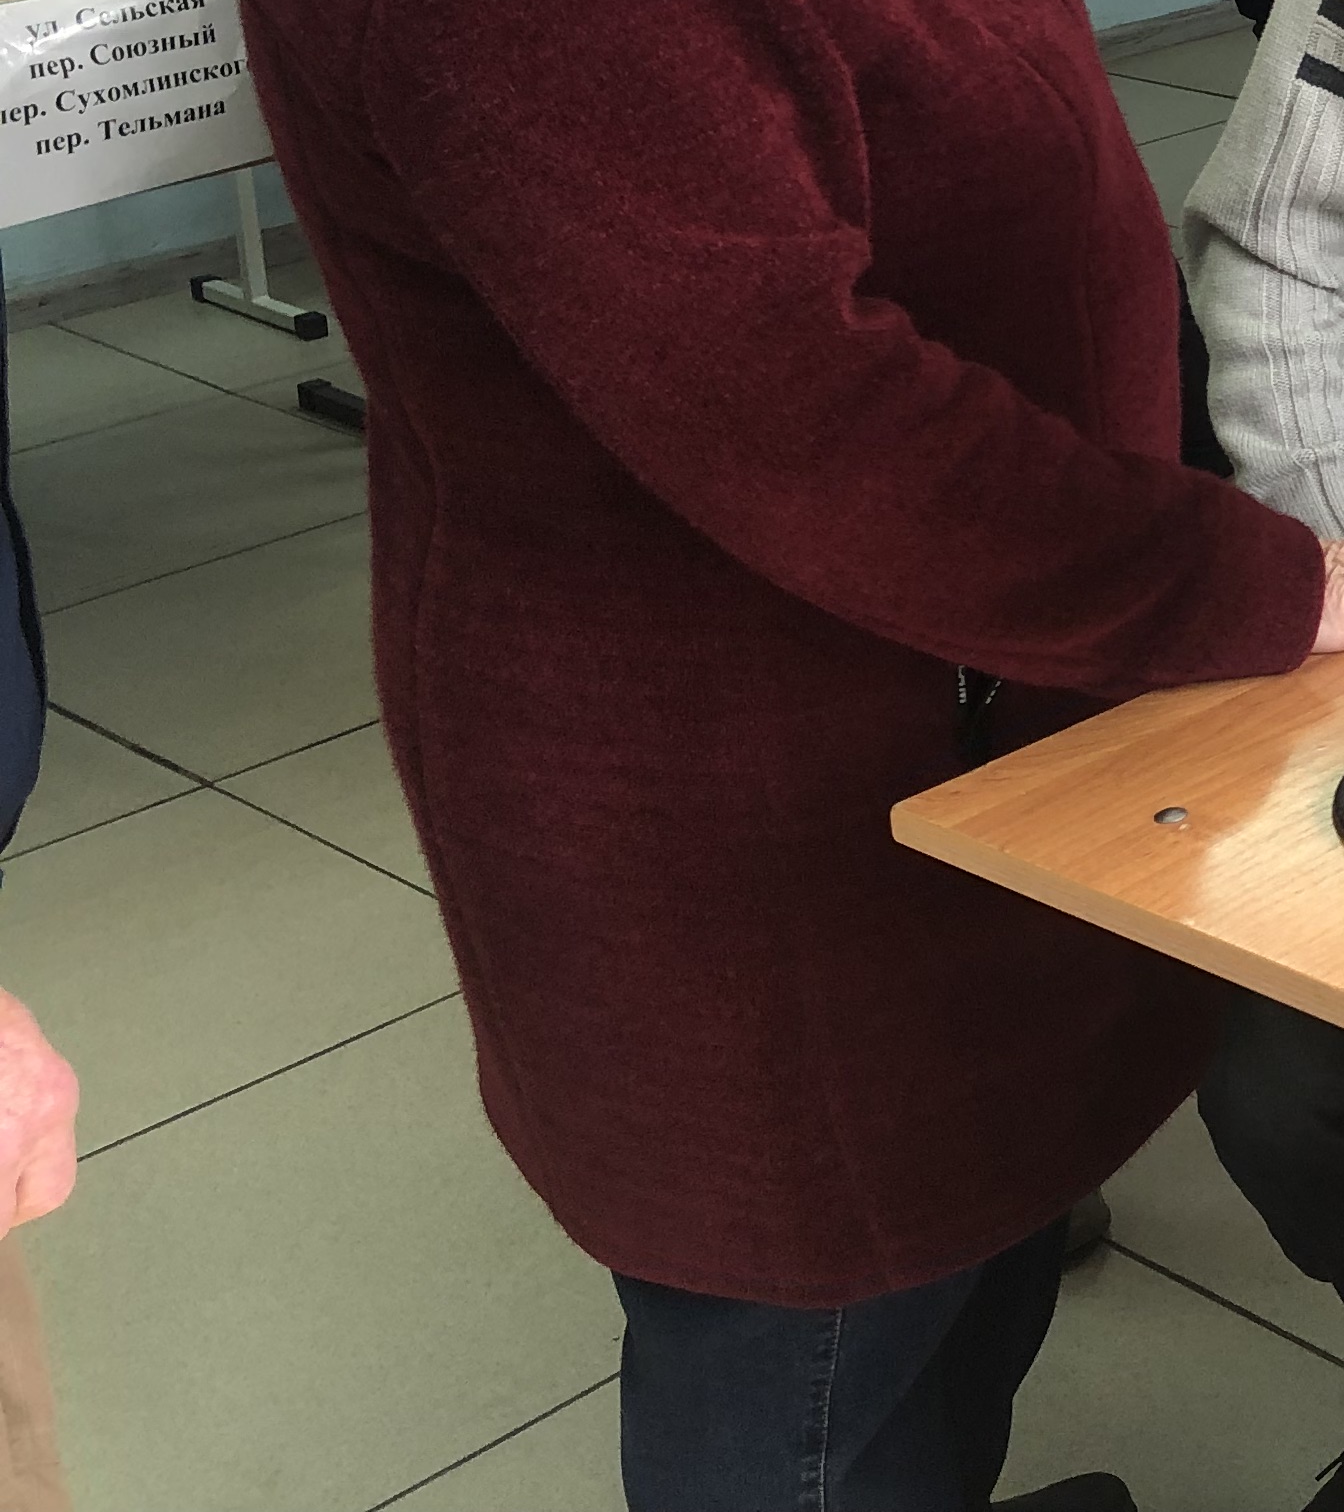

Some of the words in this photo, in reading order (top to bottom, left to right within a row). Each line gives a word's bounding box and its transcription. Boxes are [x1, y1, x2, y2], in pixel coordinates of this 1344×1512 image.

[25, 20, 58, 48] ул
[30, 56, 84, 80] пер.
[90, 23, 217, 66] Союзный
[55, 59, 249, 114] Сухомлинског
[36, 131, 90, 156] пер.
[97, 100, 226, 141] Тельмана
